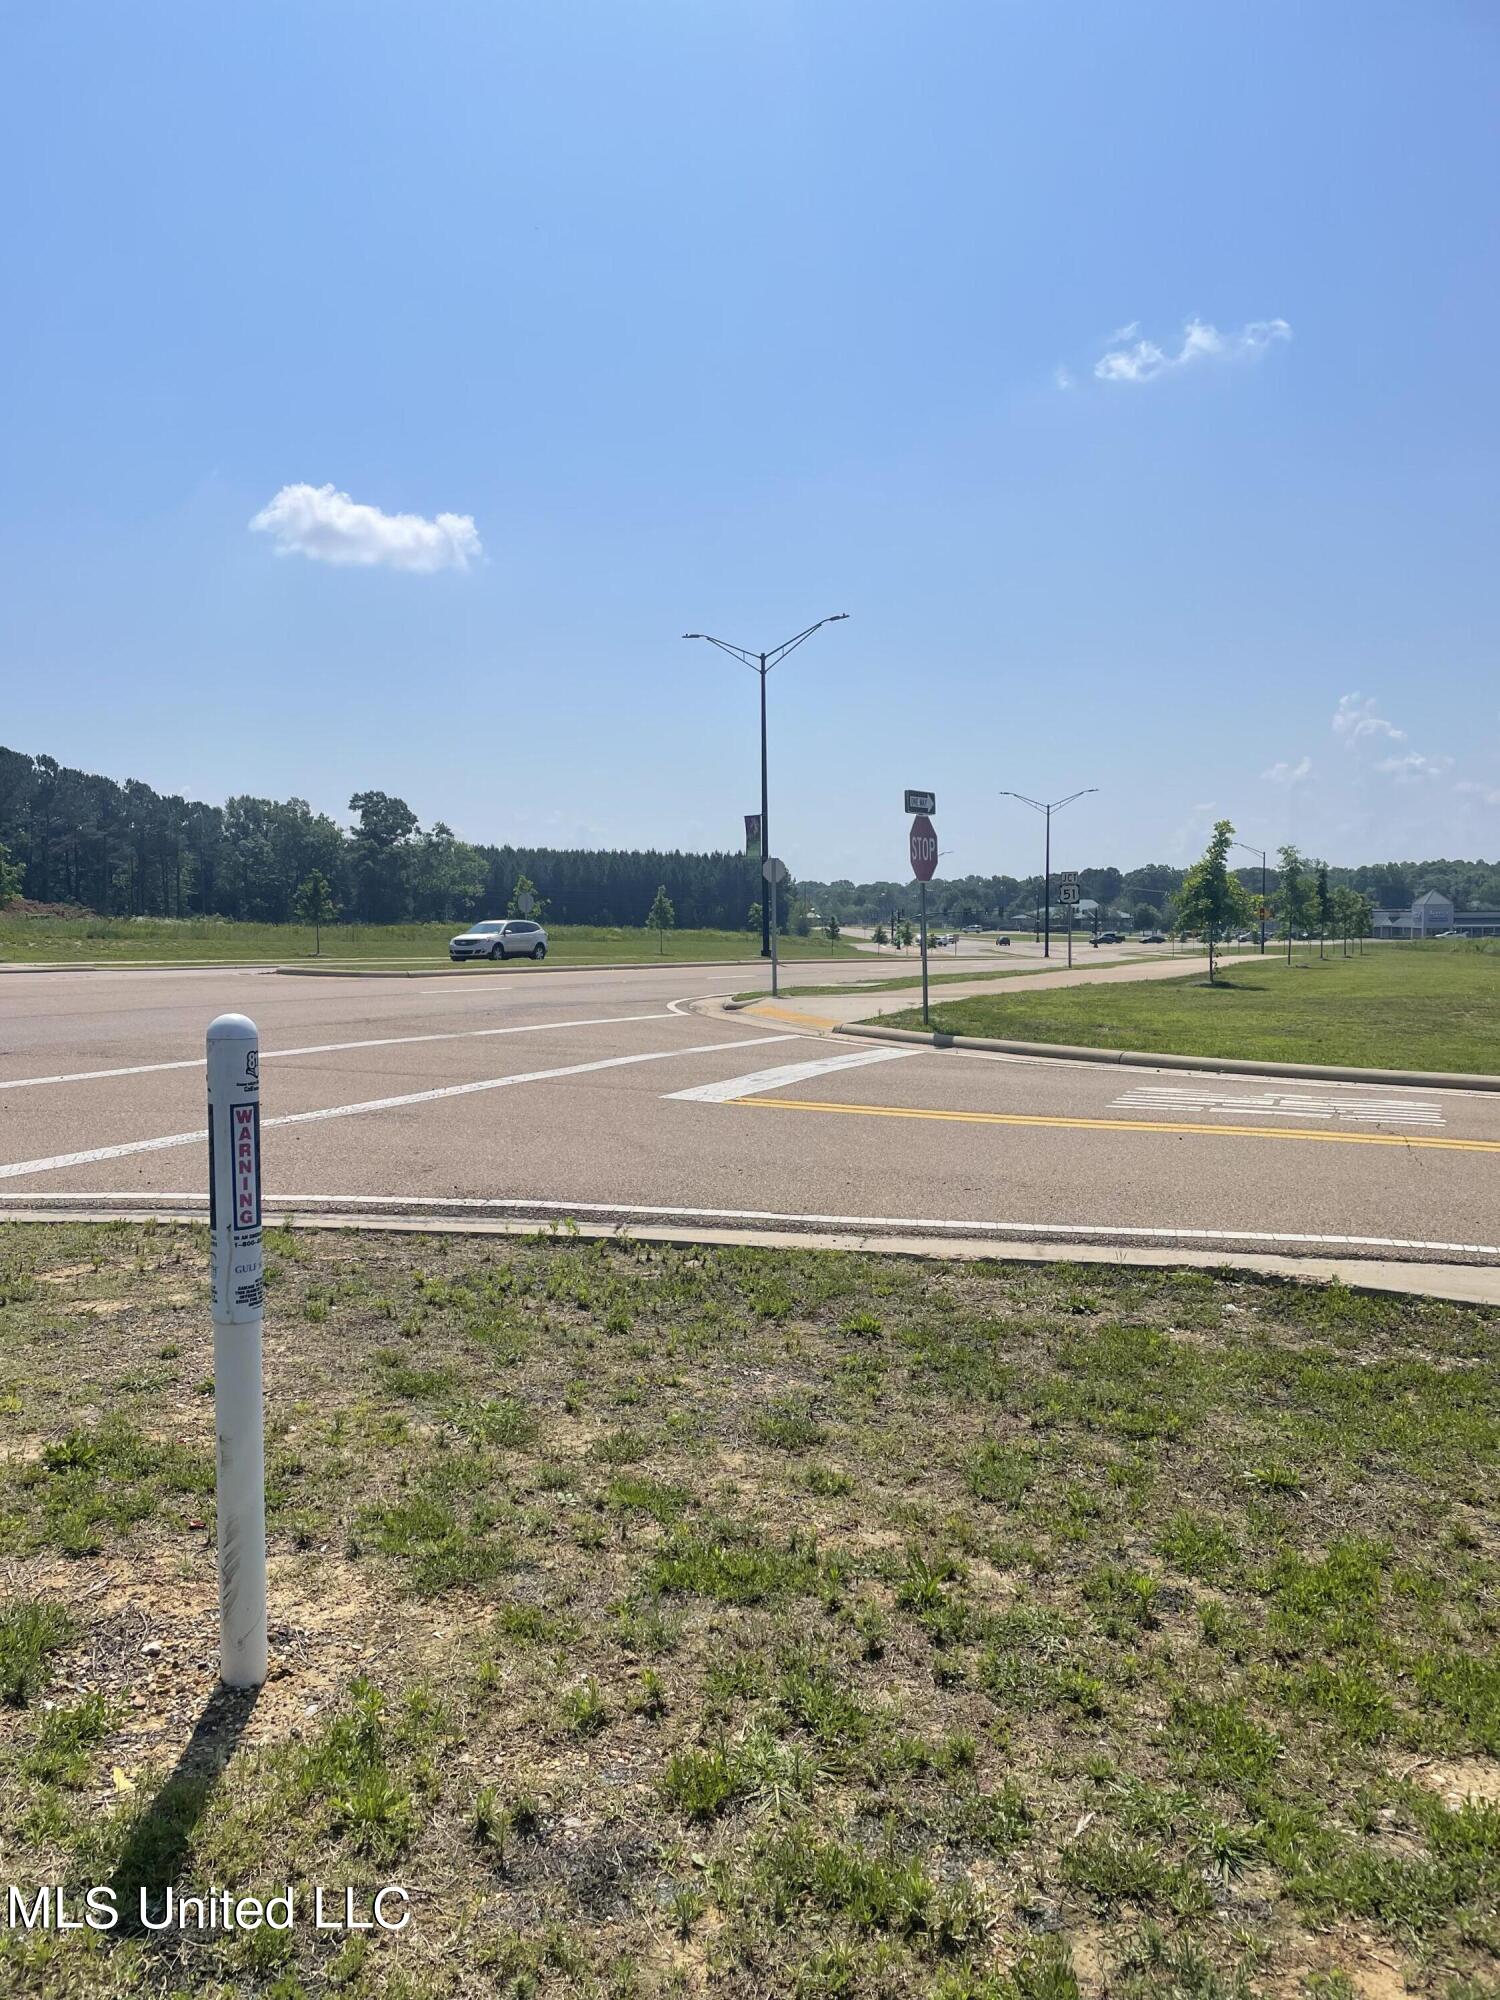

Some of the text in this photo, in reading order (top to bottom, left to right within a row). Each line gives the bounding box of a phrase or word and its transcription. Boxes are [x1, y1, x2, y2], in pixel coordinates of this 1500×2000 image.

[911, 797, 928, 808] ONE WAY
[912, 837, 935, 861] STOP
[1063, 874, 1077, 882] JCT
[1063, 889, 1075, 900] 51
[236, 1110, 253, 1223] WARNING
[235, 1263, 257, 1274] GULF
